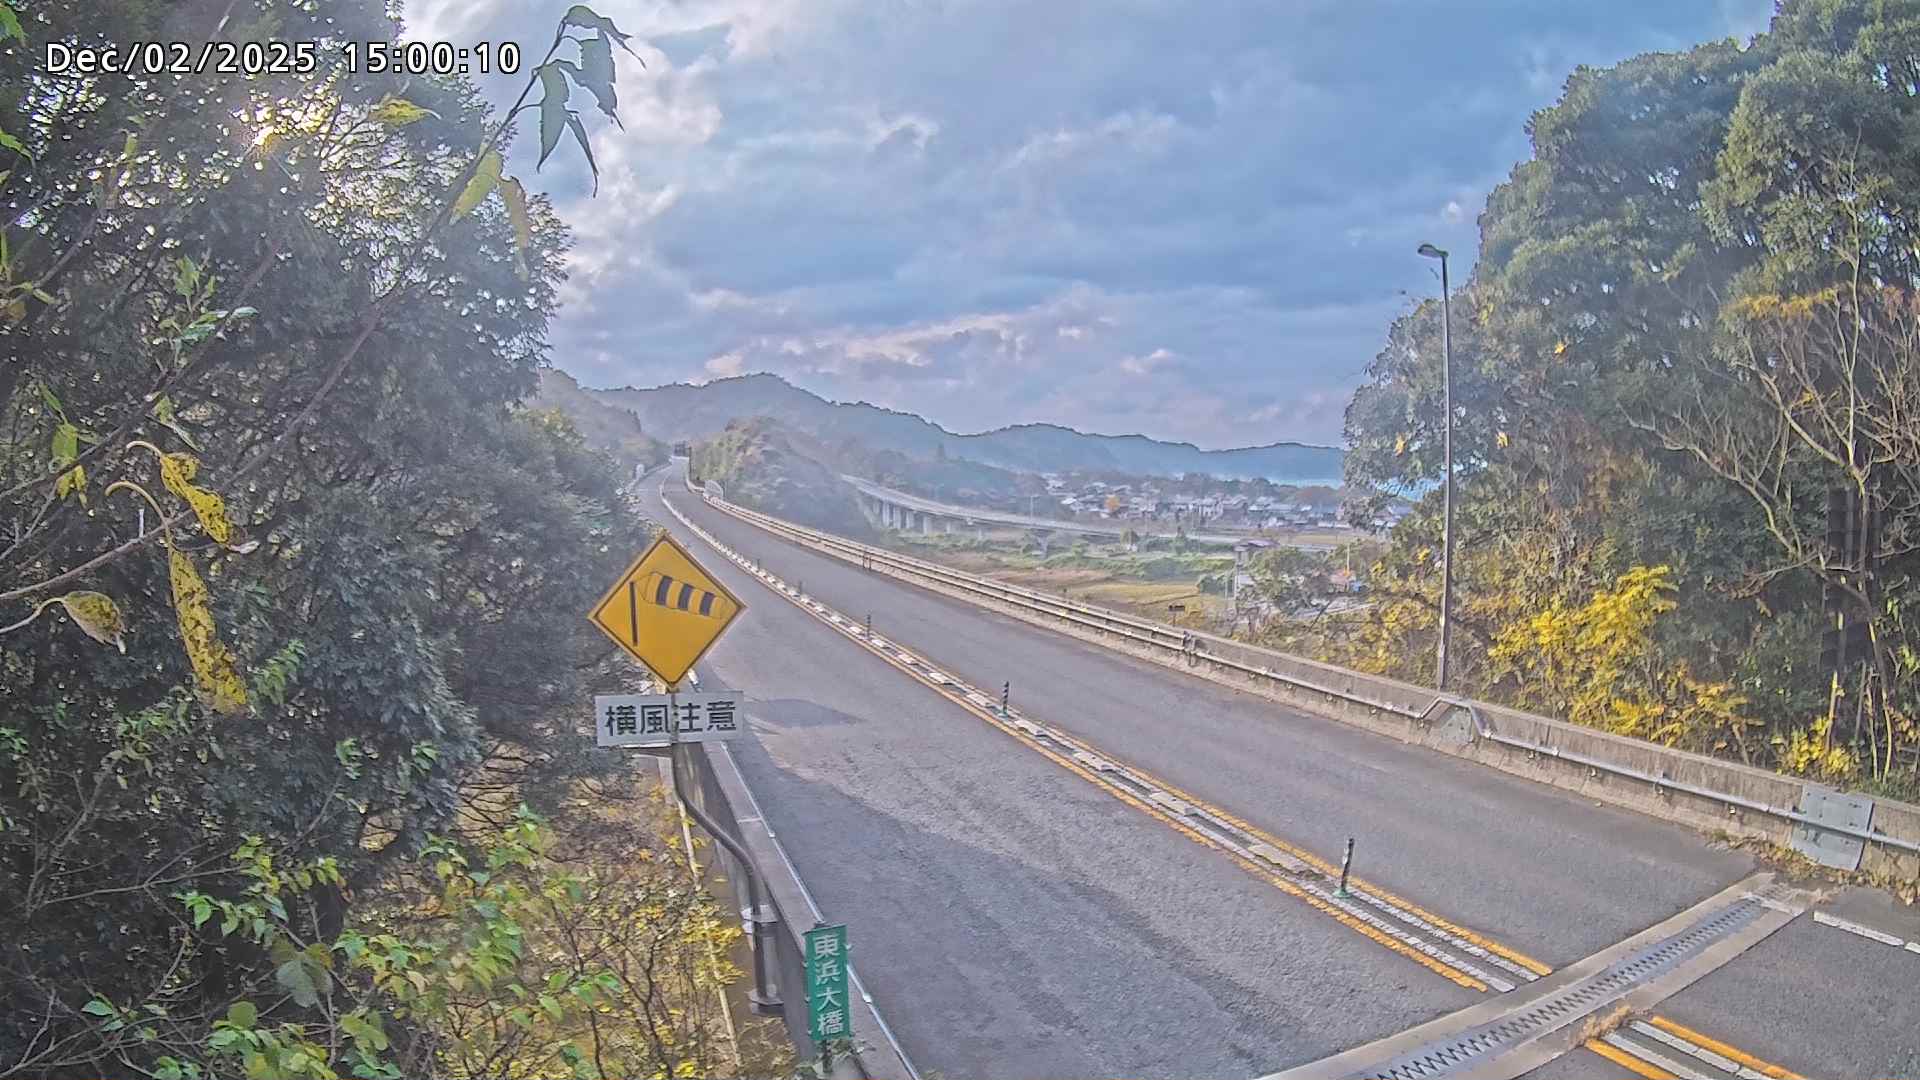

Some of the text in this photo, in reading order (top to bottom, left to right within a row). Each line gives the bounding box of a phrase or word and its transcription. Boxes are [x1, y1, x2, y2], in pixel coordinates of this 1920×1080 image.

[605, 701, 736, 736] 横風注意
[814, 934, 844, 1036] 東浜大橋
